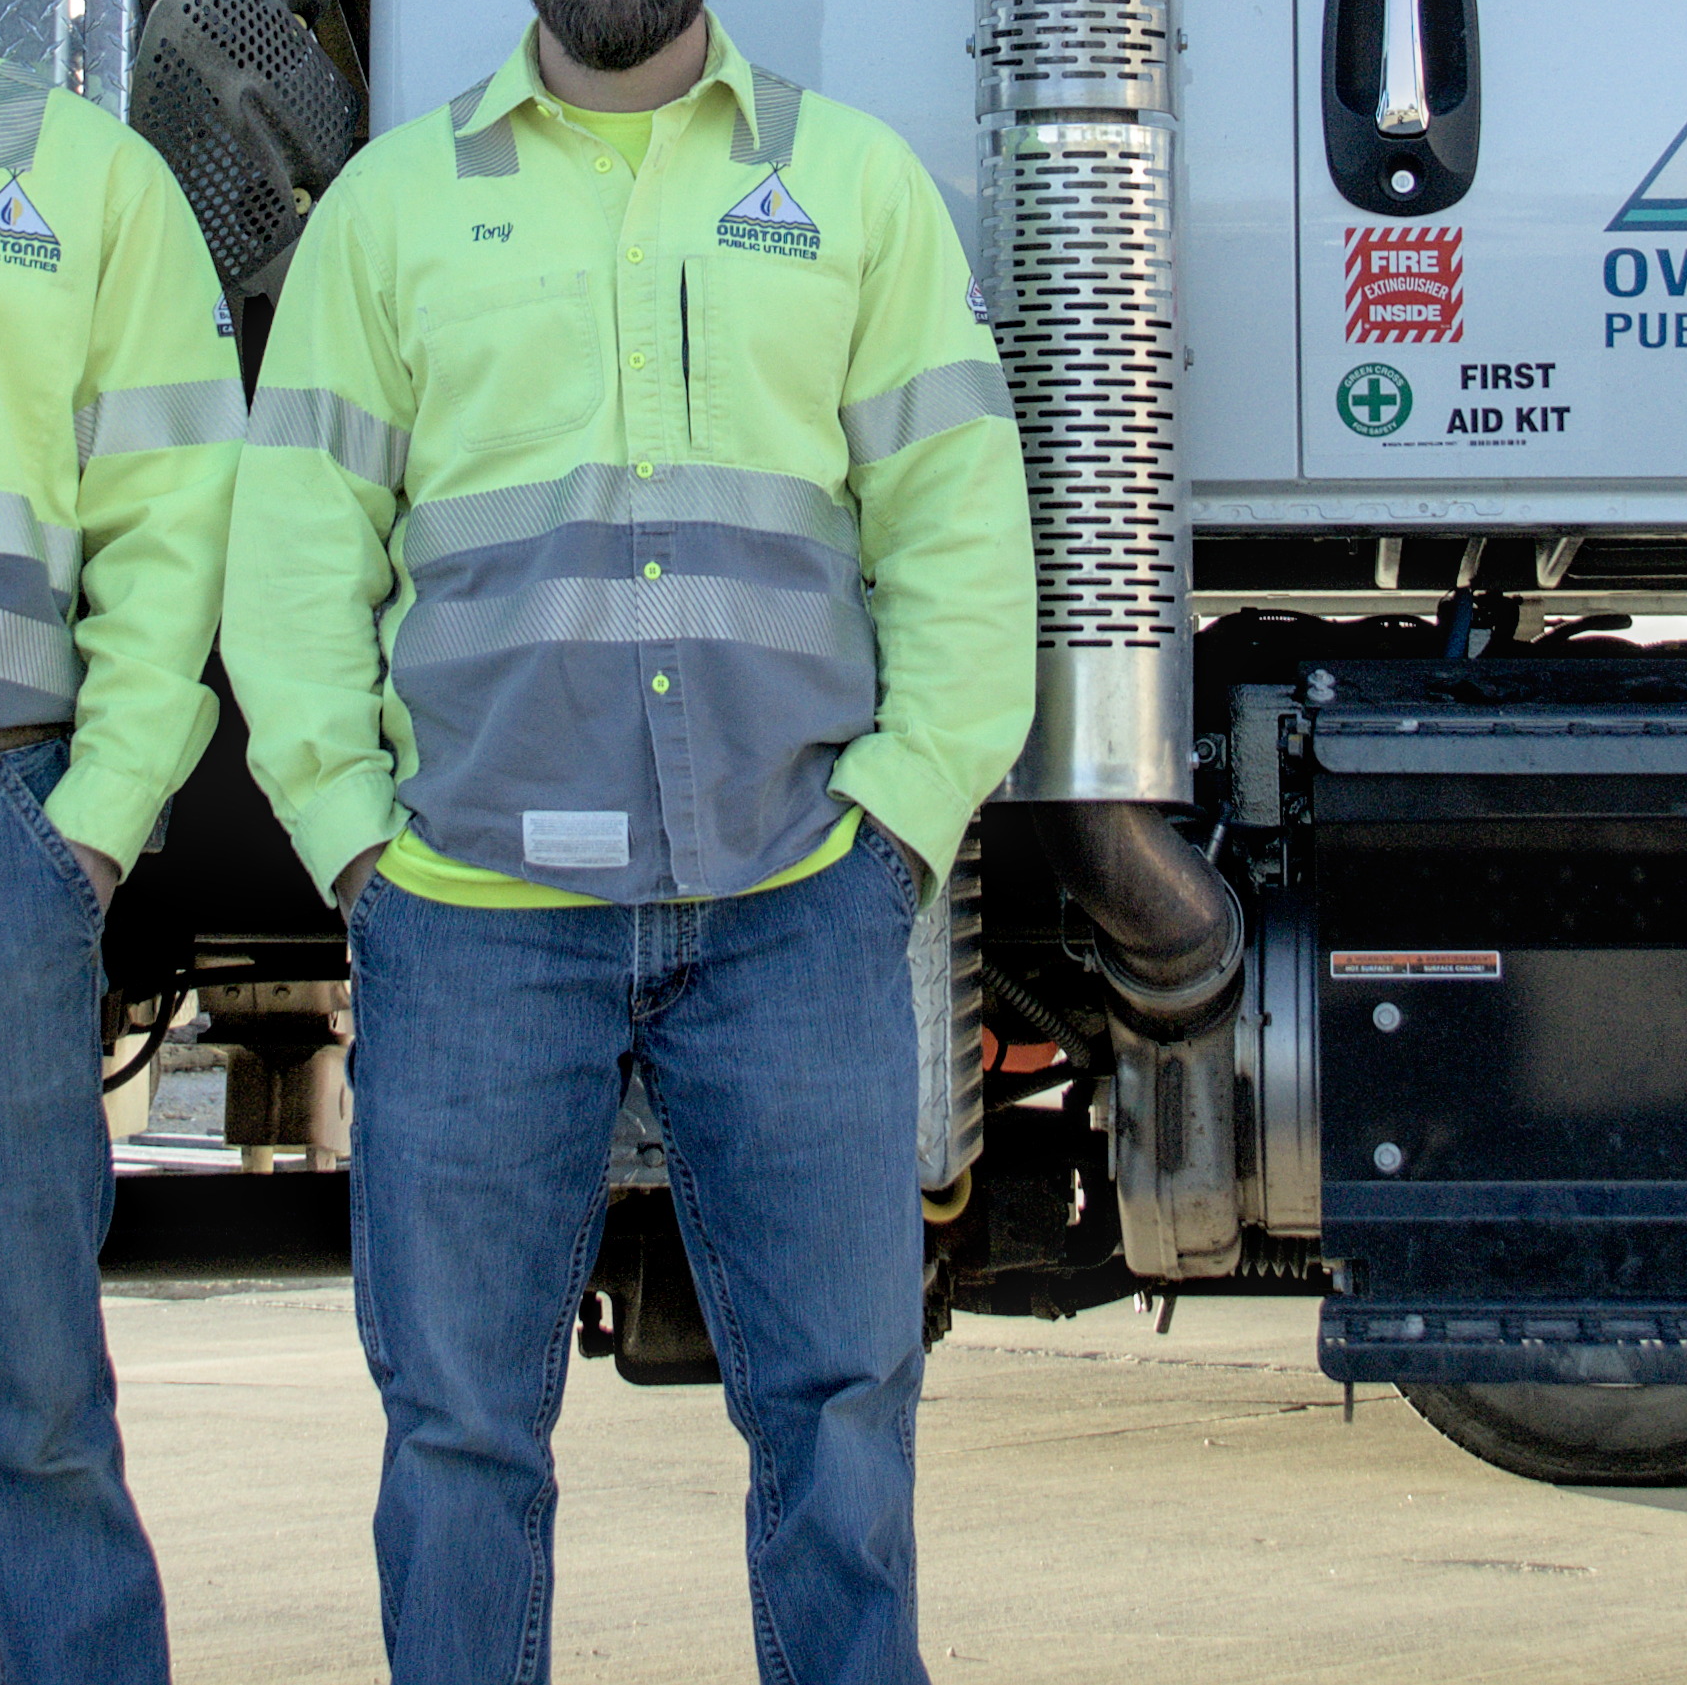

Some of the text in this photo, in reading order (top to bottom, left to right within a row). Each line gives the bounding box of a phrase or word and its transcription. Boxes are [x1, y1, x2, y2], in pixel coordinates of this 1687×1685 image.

[471, 222, 514, 243] Tony
[716, 224, 821, 250] OWATONNA
[718, 238, 817, 260] PUBLIC UTILITIES
[4, 254, 58, 273] UTILITIES
[1370, 250, 1439, 273] FIRE
[1363, 276, 1449, 300] EXTINGUISHER
[1369, 304, 1442, 322] INSIDE
[1343, 365, 1404, 389] GREEN CROSS
[1460, 362, 1556, 390] FIRST
[1351, 421, 1398, 436] FOR SAFETY
[1446, 406, 1571, 434] AID KIT
